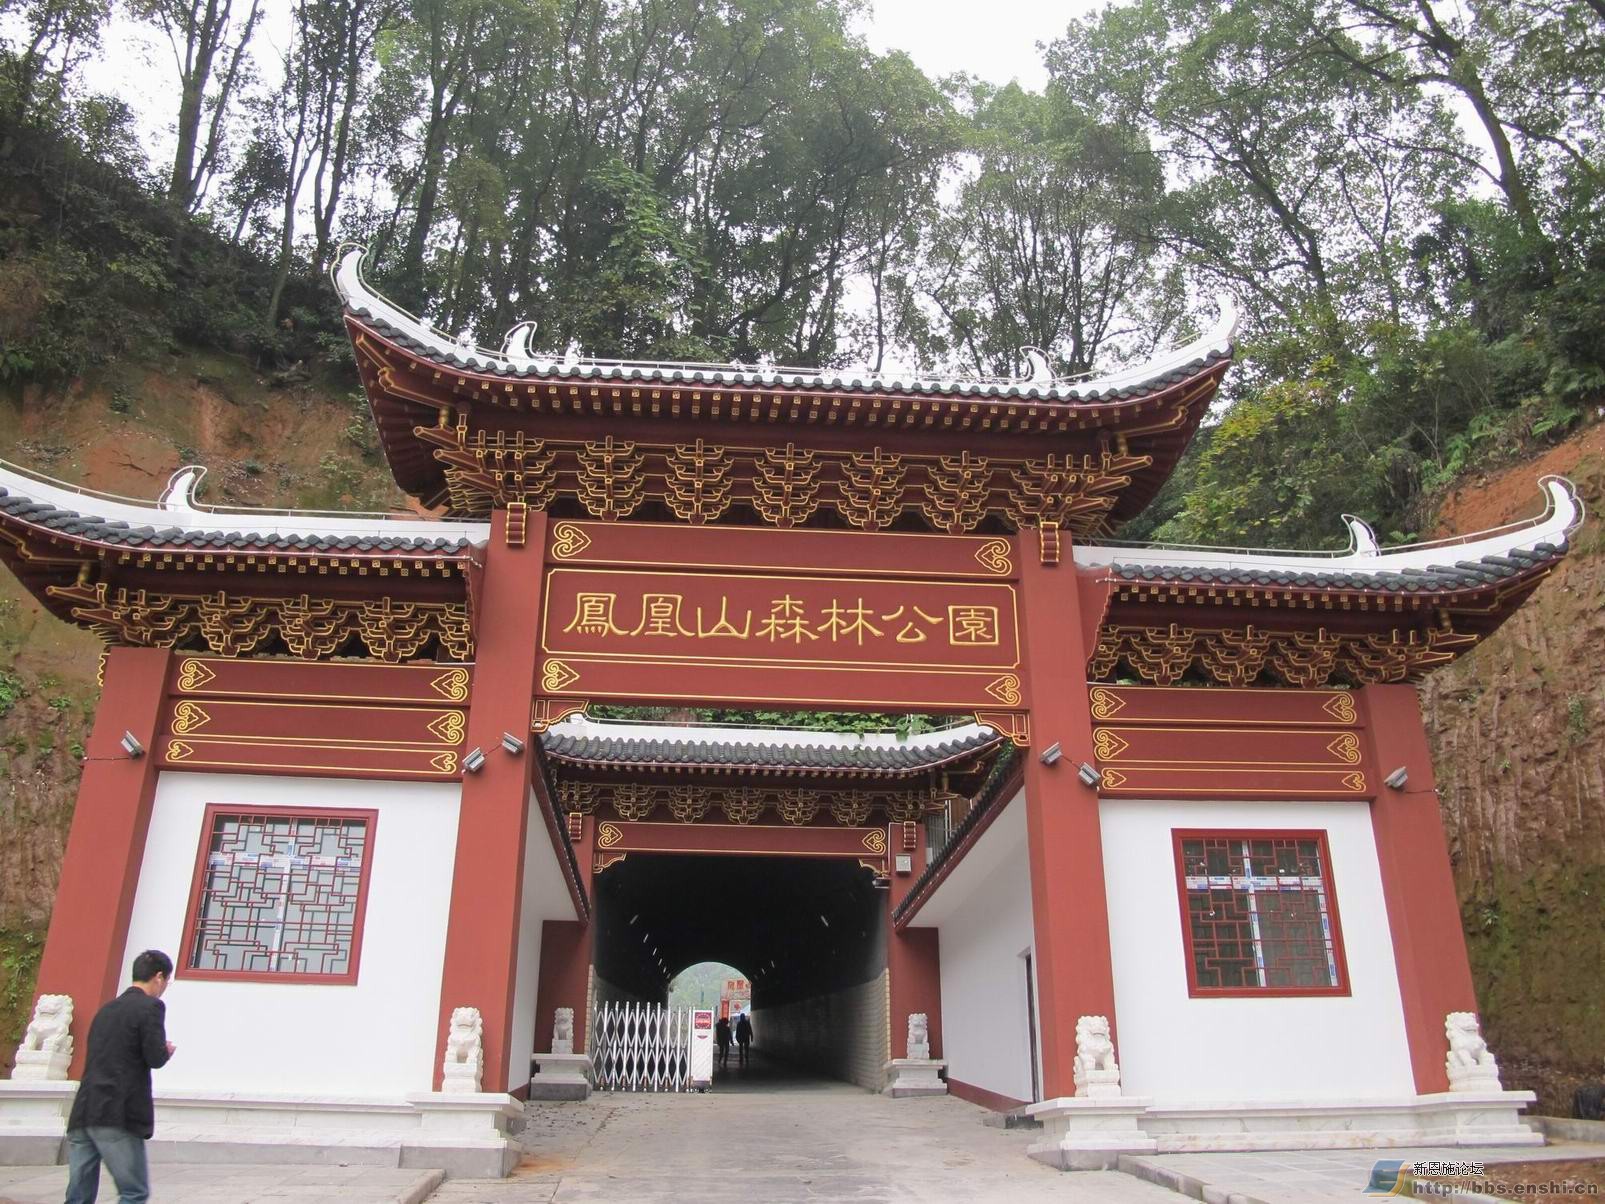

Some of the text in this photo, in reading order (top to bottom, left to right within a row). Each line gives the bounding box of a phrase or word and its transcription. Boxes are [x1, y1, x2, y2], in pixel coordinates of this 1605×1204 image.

[563, 592, 1000, 646] 鳳凰山森林公園
